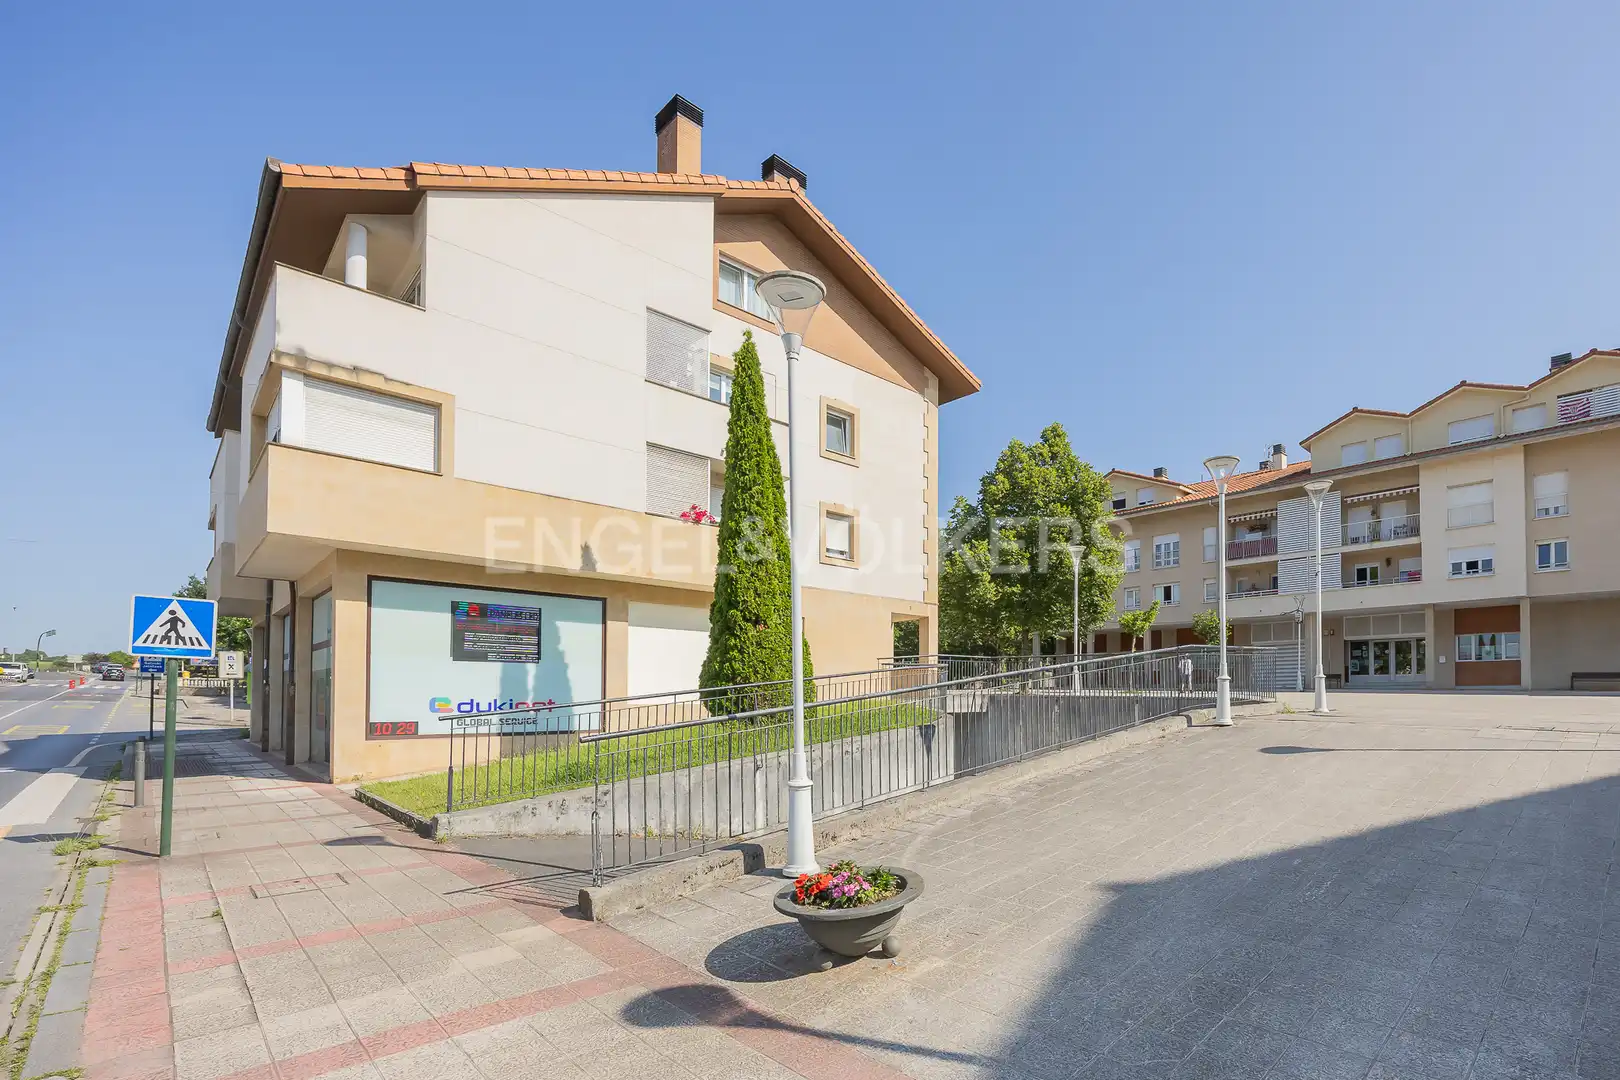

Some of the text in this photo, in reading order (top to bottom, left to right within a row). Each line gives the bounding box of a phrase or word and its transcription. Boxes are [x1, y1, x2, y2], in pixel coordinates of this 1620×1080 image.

[456, 717, 538, 727] GLOBAL SERVICE
[374, 722, 415, 736] 10 29
